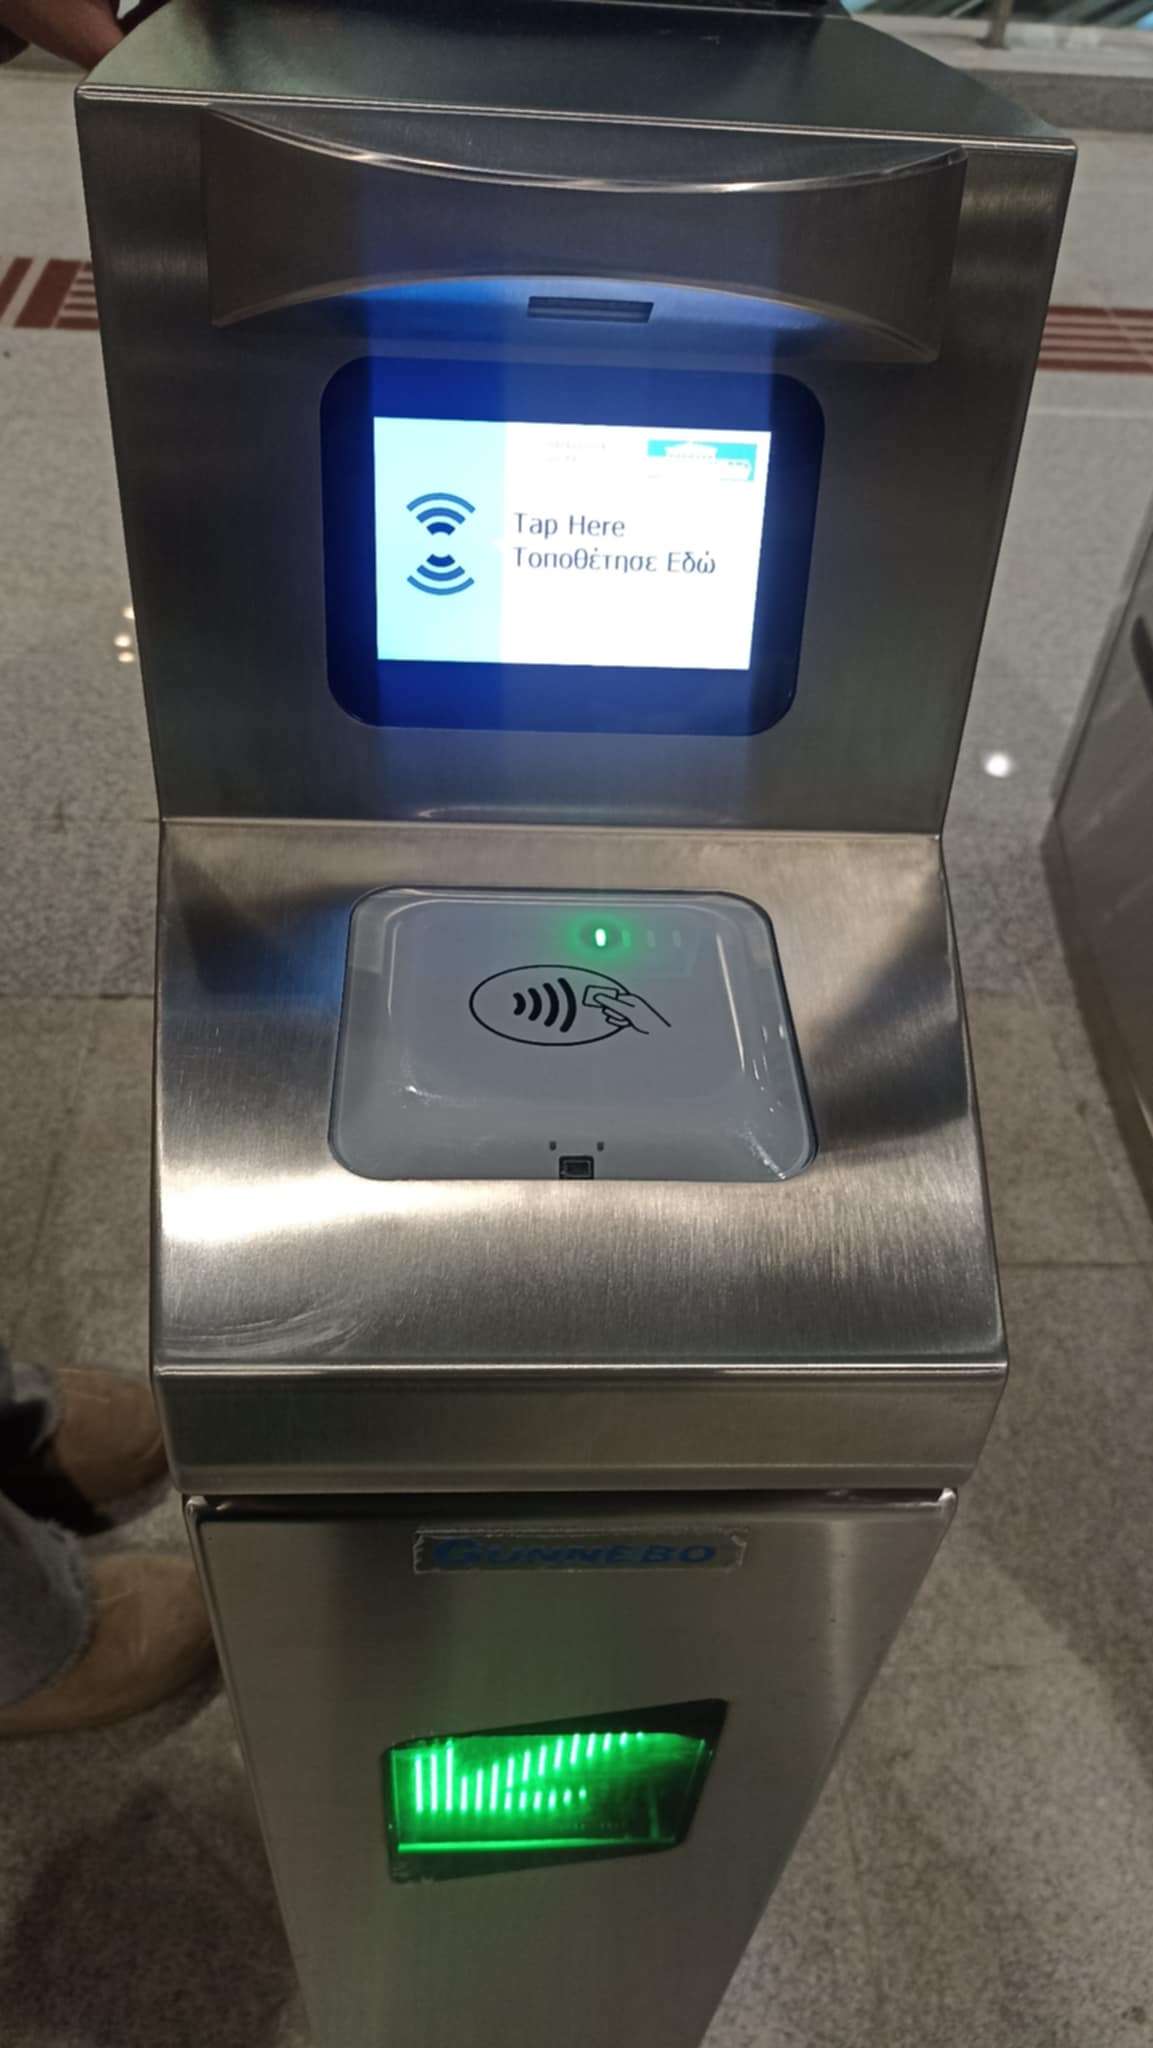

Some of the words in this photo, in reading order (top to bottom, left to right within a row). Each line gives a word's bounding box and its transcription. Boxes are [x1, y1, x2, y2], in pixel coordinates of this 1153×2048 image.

[514, 513, 558, 539] Tap
[569, 515, 626, 537] Here
[514, 547, 657, 574] Τοποθέτησε
[667, 551, 716, 574] Εδώ
[432, 1537, 716, 1566] GUNNEBO
